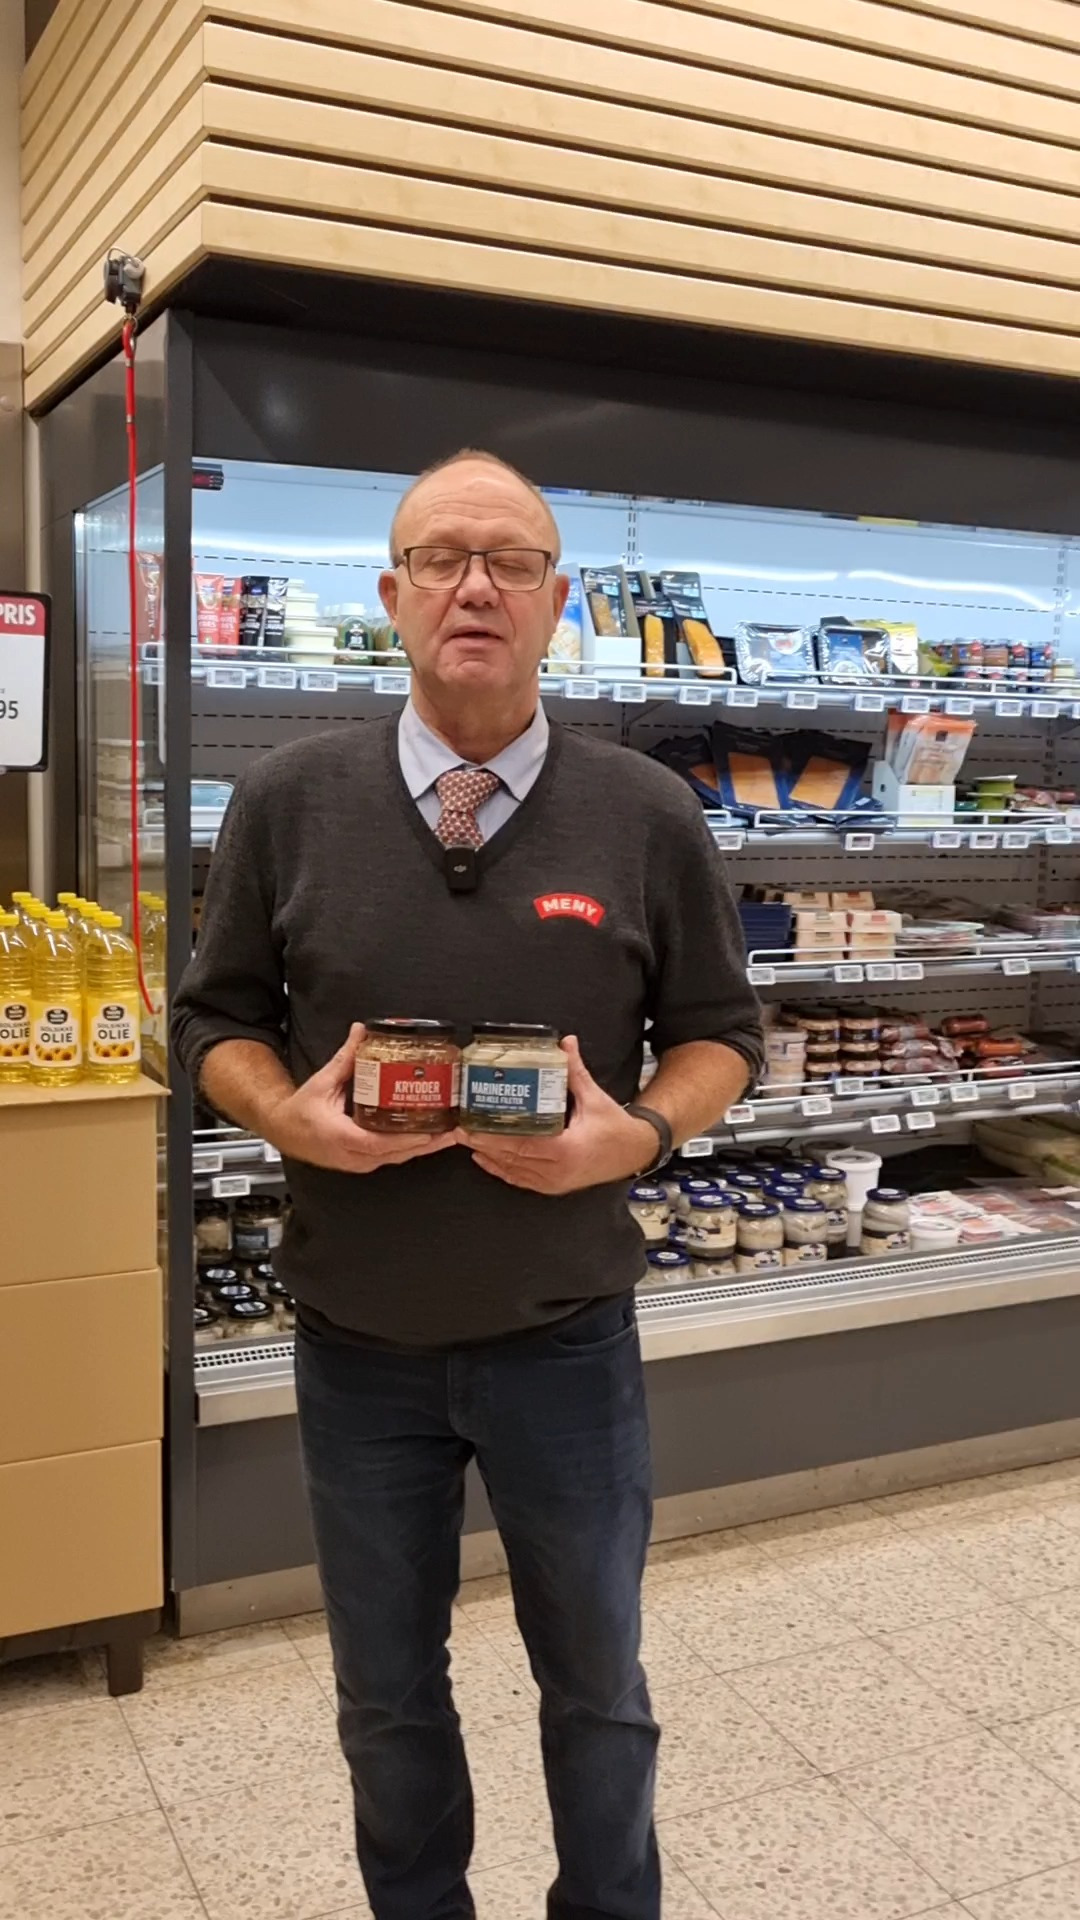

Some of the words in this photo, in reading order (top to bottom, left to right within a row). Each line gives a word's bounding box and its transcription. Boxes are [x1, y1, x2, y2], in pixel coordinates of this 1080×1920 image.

[541, 898, 598, 917] MENY
[0, 1028, 30, 1039] OLIE
[41, 1032, 73, 1043] OLIE
[98, 1029, 130, 1039] OLIE
[395, 1080, 440, 1094] KRYDDER
[472, 1081, 530, 1097] MARINEREDE
